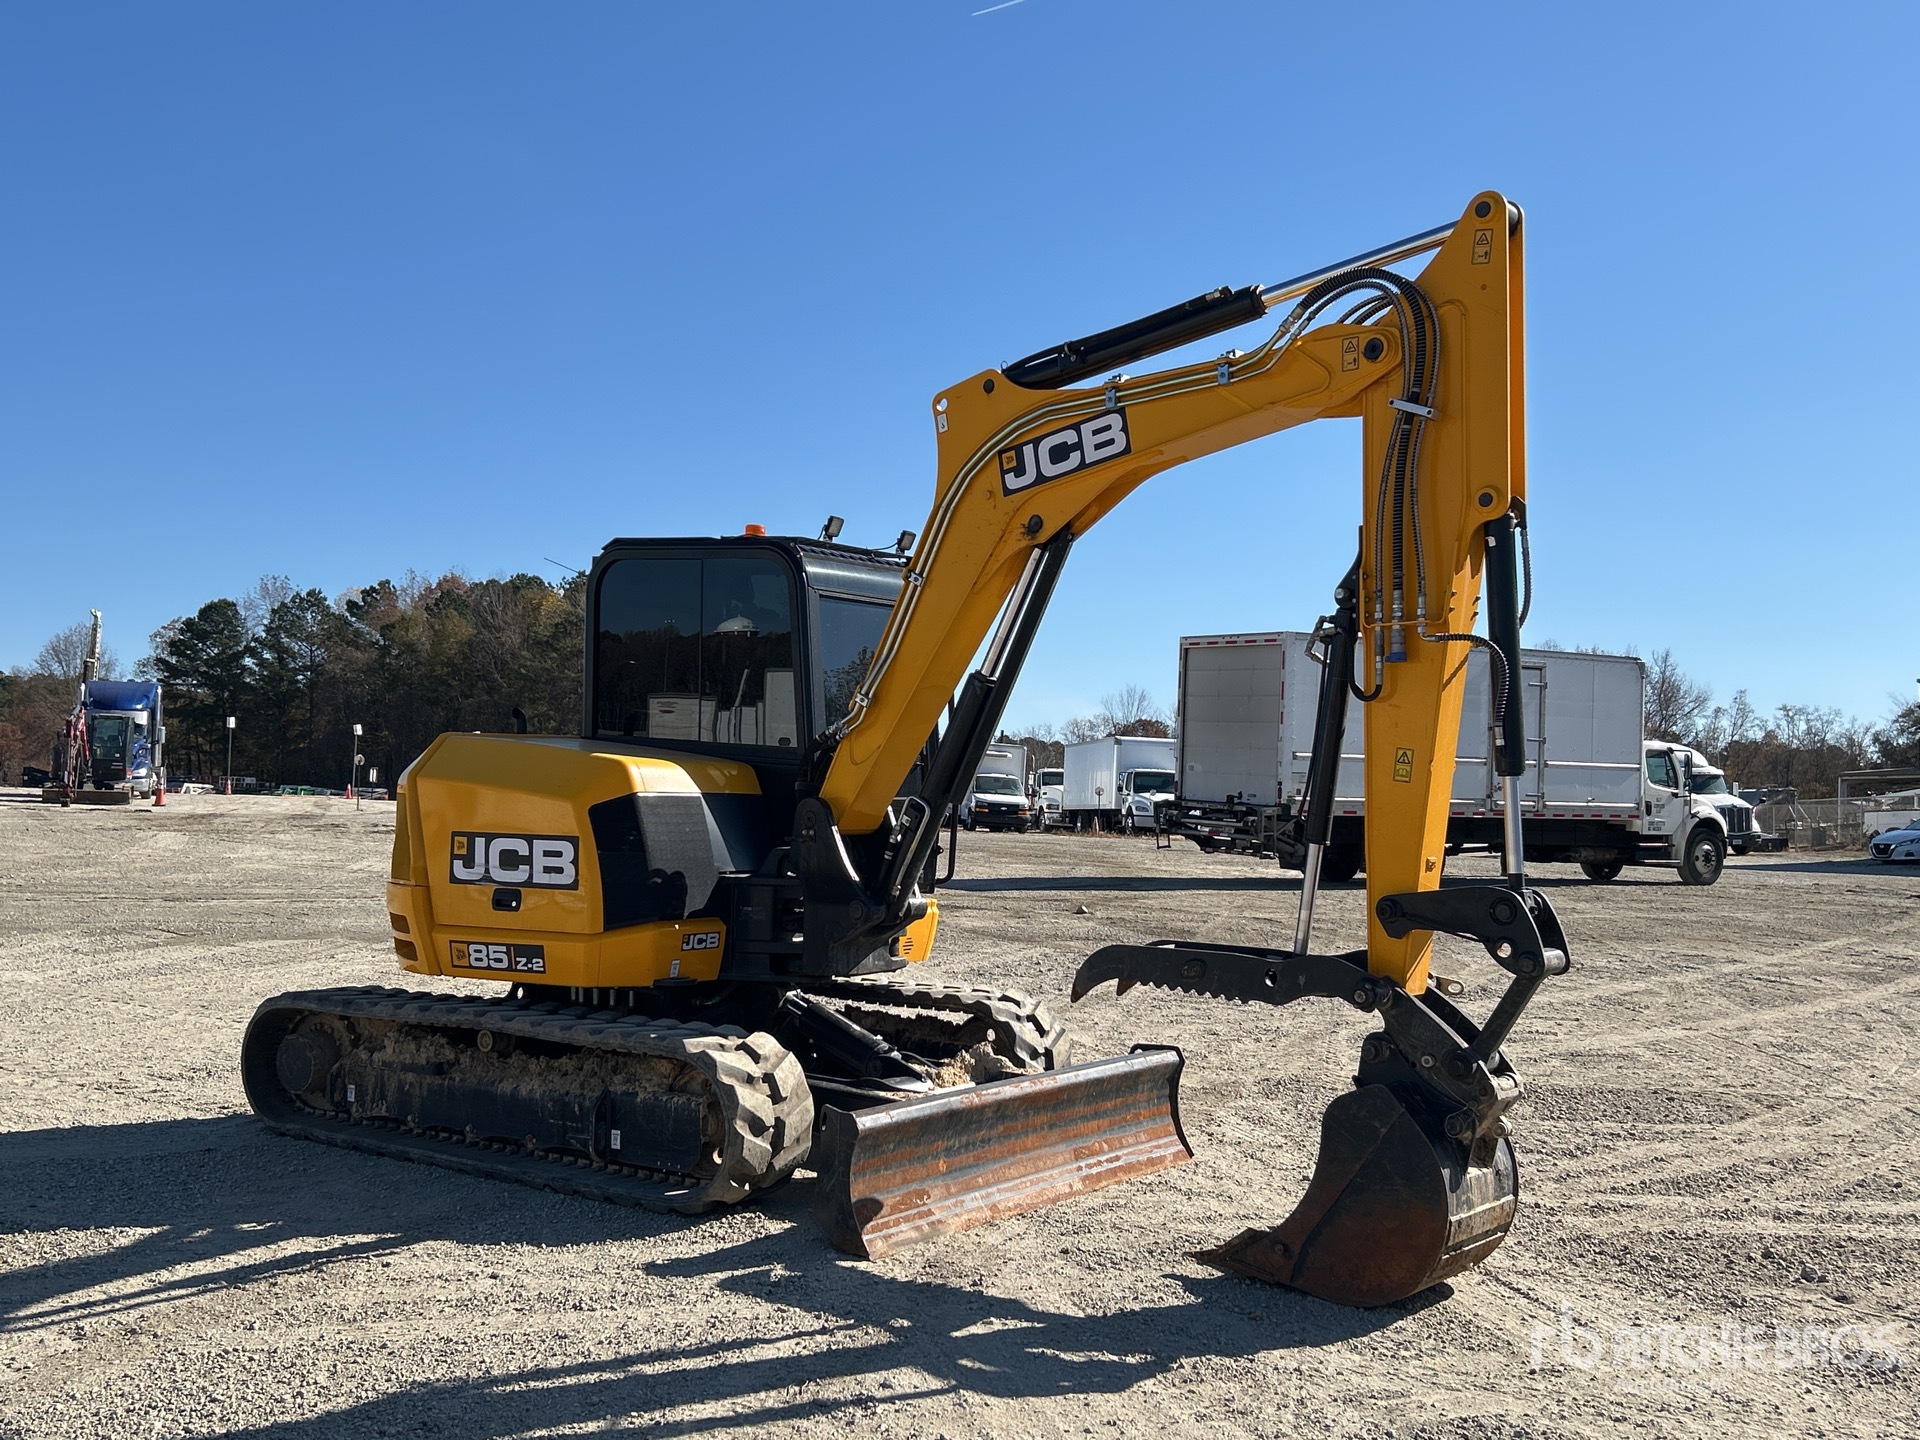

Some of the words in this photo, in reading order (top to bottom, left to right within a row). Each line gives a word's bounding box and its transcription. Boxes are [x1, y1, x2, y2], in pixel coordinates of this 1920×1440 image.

[1004, 413, 1127, 490] JCB
[453, 837, 576, 885] JCB
[468, 944, 509, 969] 85
[682, 933, 720, 950] JCB
